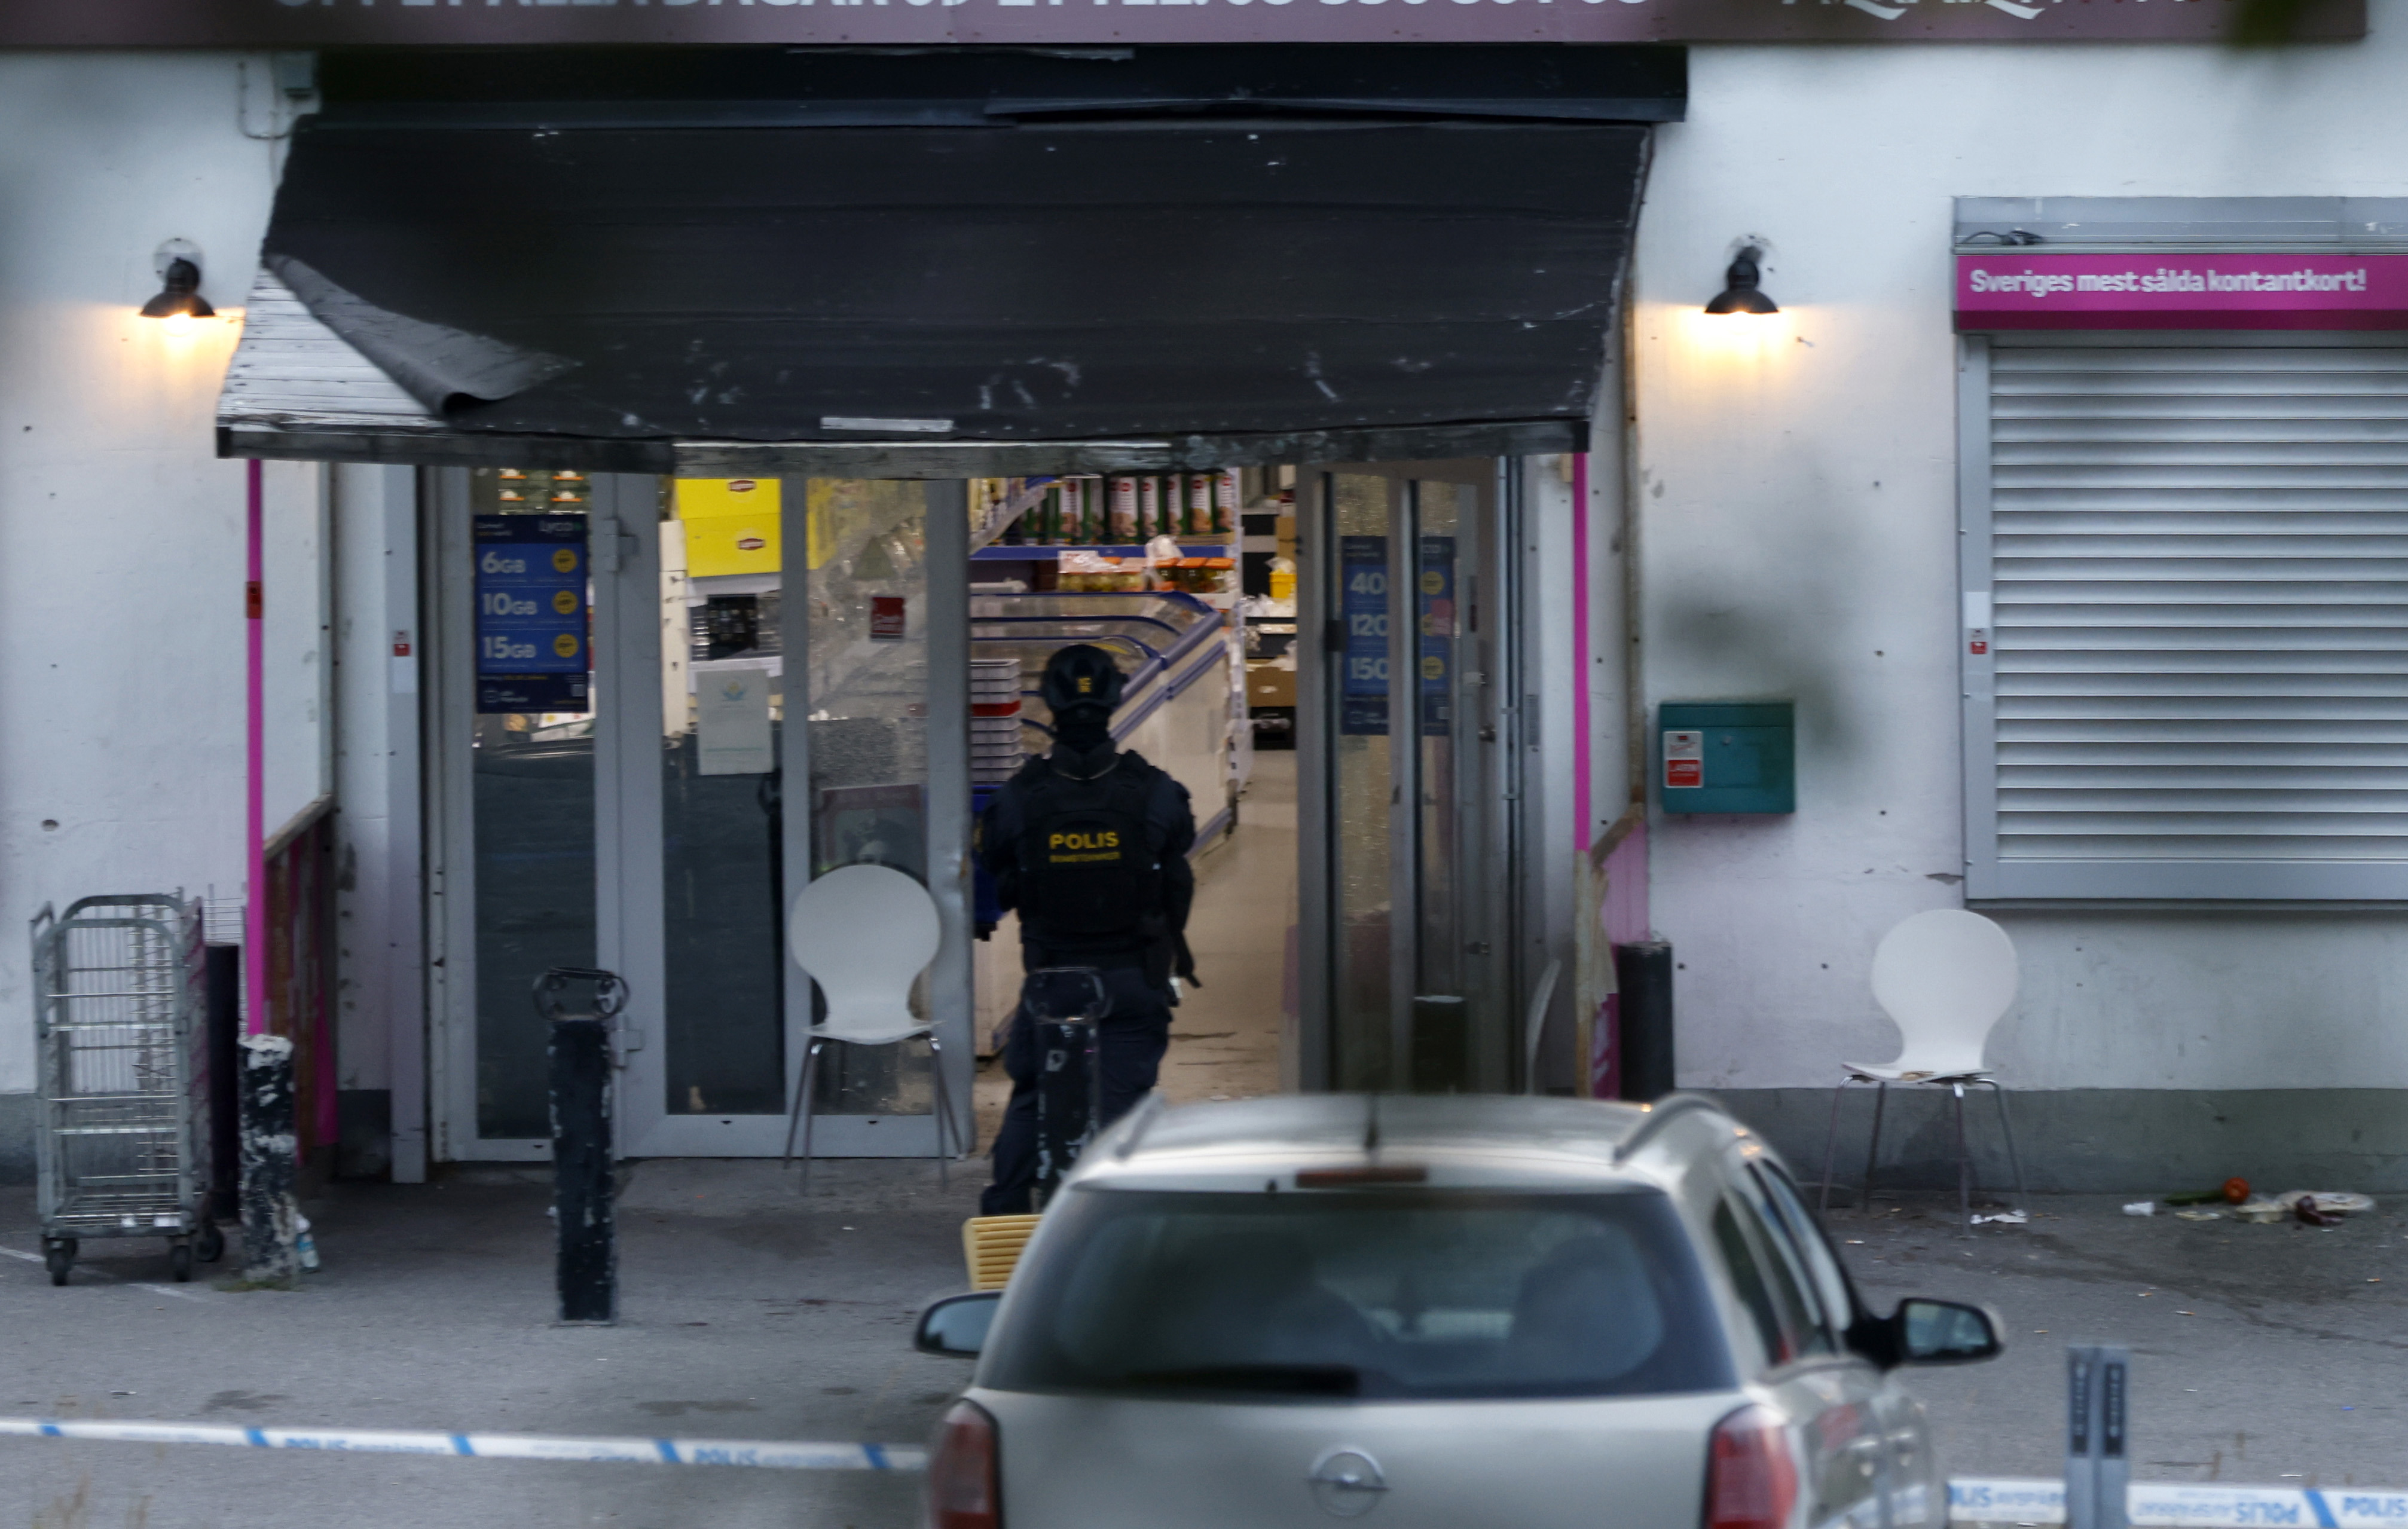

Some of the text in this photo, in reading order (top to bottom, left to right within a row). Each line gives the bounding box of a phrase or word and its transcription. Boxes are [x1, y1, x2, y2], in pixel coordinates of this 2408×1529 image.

[1970, 268, 2367, 297] Sveriges mest sålda kontantkort!
[481, 552, 525, 574] 6GB
[482, 593, 537, 616] 10GB
[482, 637, 536, 658] 15GB
[1049, 832, 1119, 849] POLIS
[2342, 1497, 2408, 1518] POLIS
